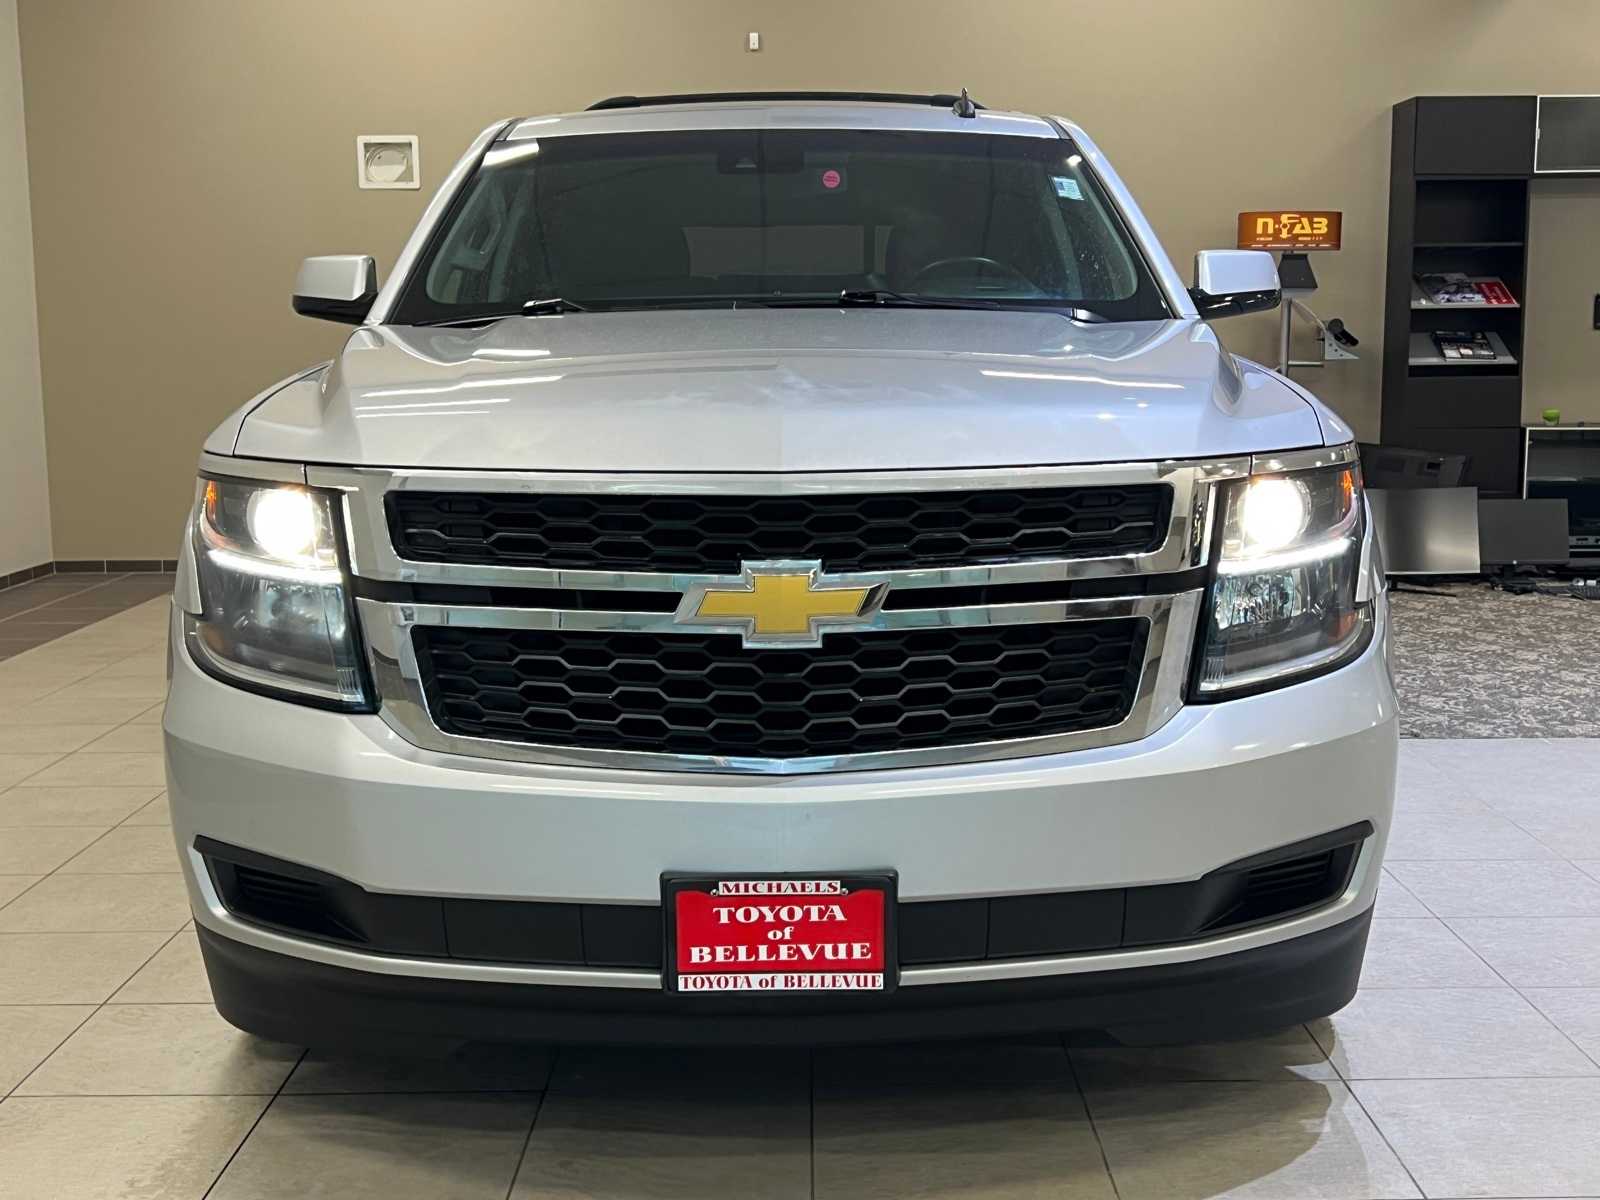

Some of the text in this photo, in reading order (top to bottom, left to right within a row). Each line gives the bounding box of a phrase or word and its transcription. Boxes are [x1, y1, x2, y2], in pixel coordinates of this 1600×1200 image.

[722, 882, 839, 894] MICHAELS
[713, 905, 847, 924] TOYOTA
[767, 926, 794, 940] of
[689, 942, 872, 963] BELLEVUE
[680, 974, 882, 990] TOYOTA of BELLEVUE
